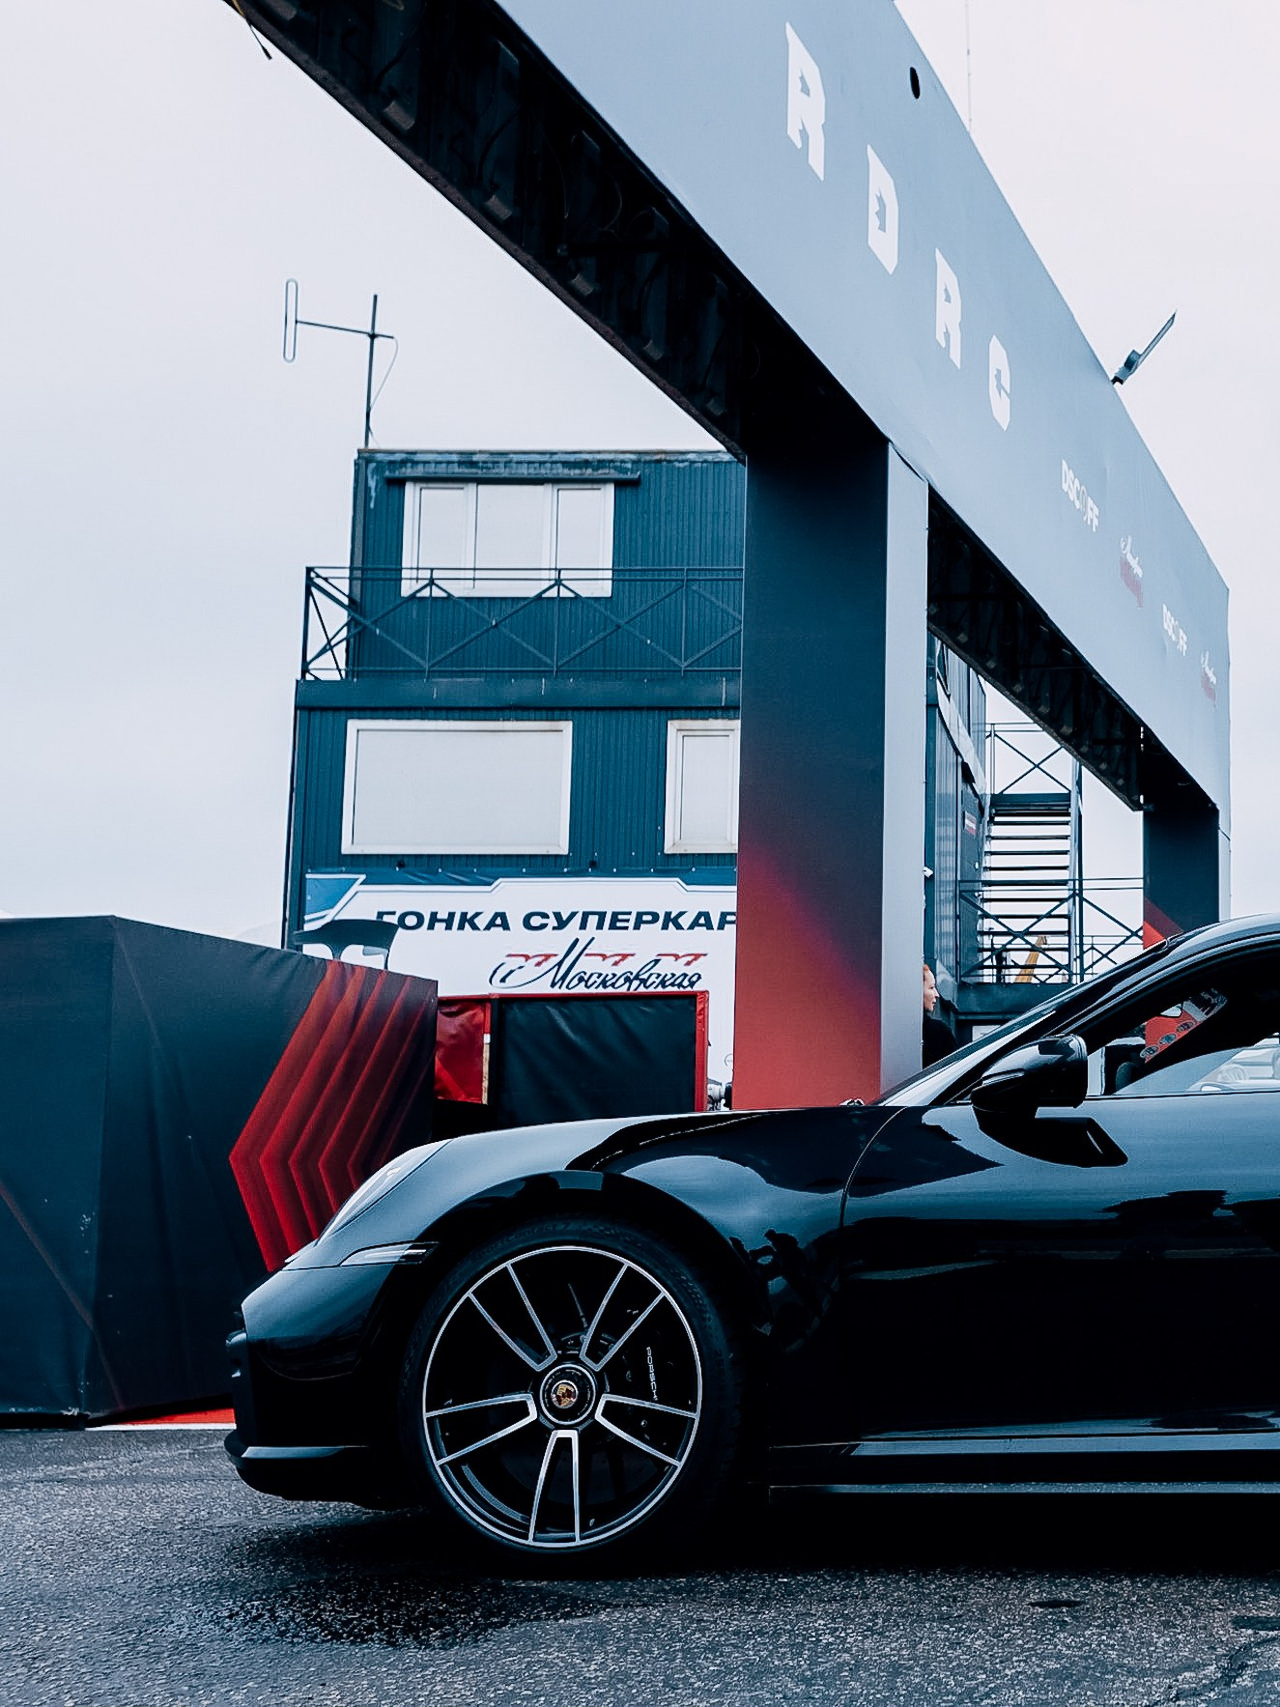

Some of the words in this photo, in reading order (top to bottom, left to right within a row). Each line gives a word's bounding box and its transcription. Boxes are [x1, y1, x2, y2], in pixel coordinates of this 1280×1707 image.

[376, 910, 510, 931] ГОНКА
[522, 910, 737, 932] СУПЕРКАР
[489, 936, 702, 991] Московская
[645, 1346, 659, 1401] PORSCH
